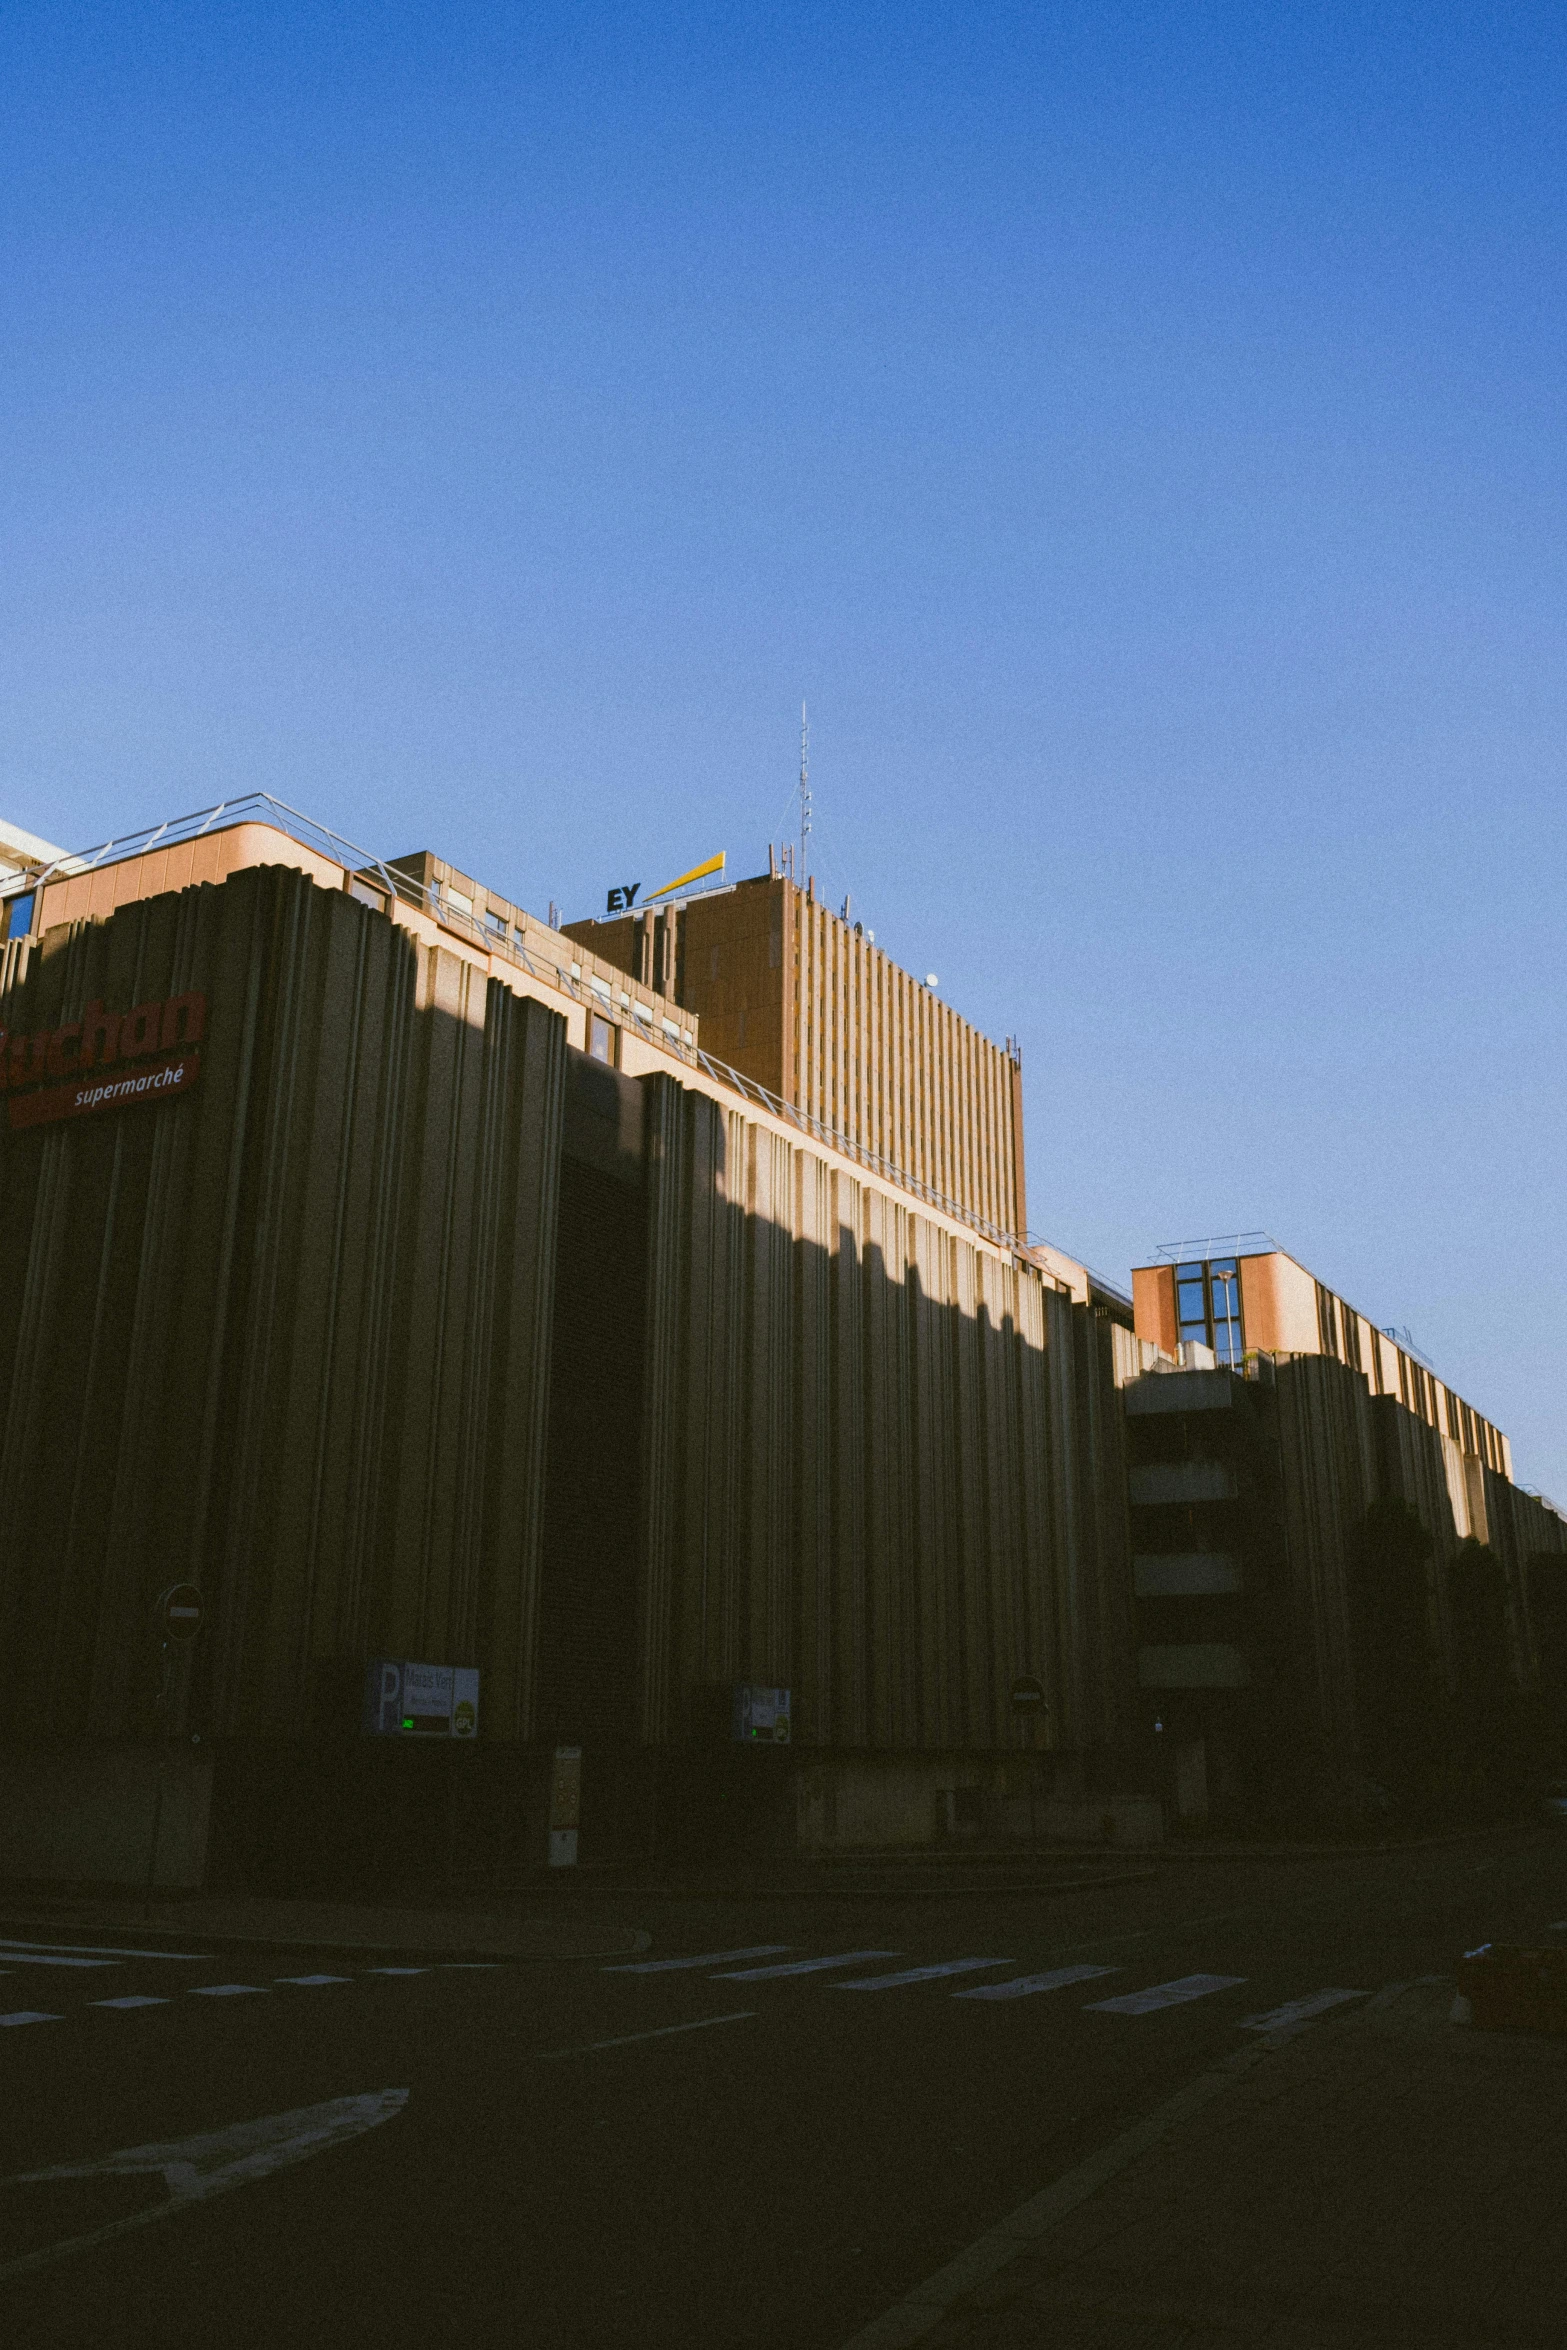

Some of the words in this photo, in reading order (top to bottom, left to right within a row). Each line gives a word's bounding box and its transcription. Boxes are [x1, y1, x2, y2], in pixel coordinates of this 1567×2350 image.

[607, 883, 640, 912] EY
[0, 991, 206, 1088] uchan
[74, 1062, 184, 1107] supermarché
[379, 1663, 400, 1730] P
